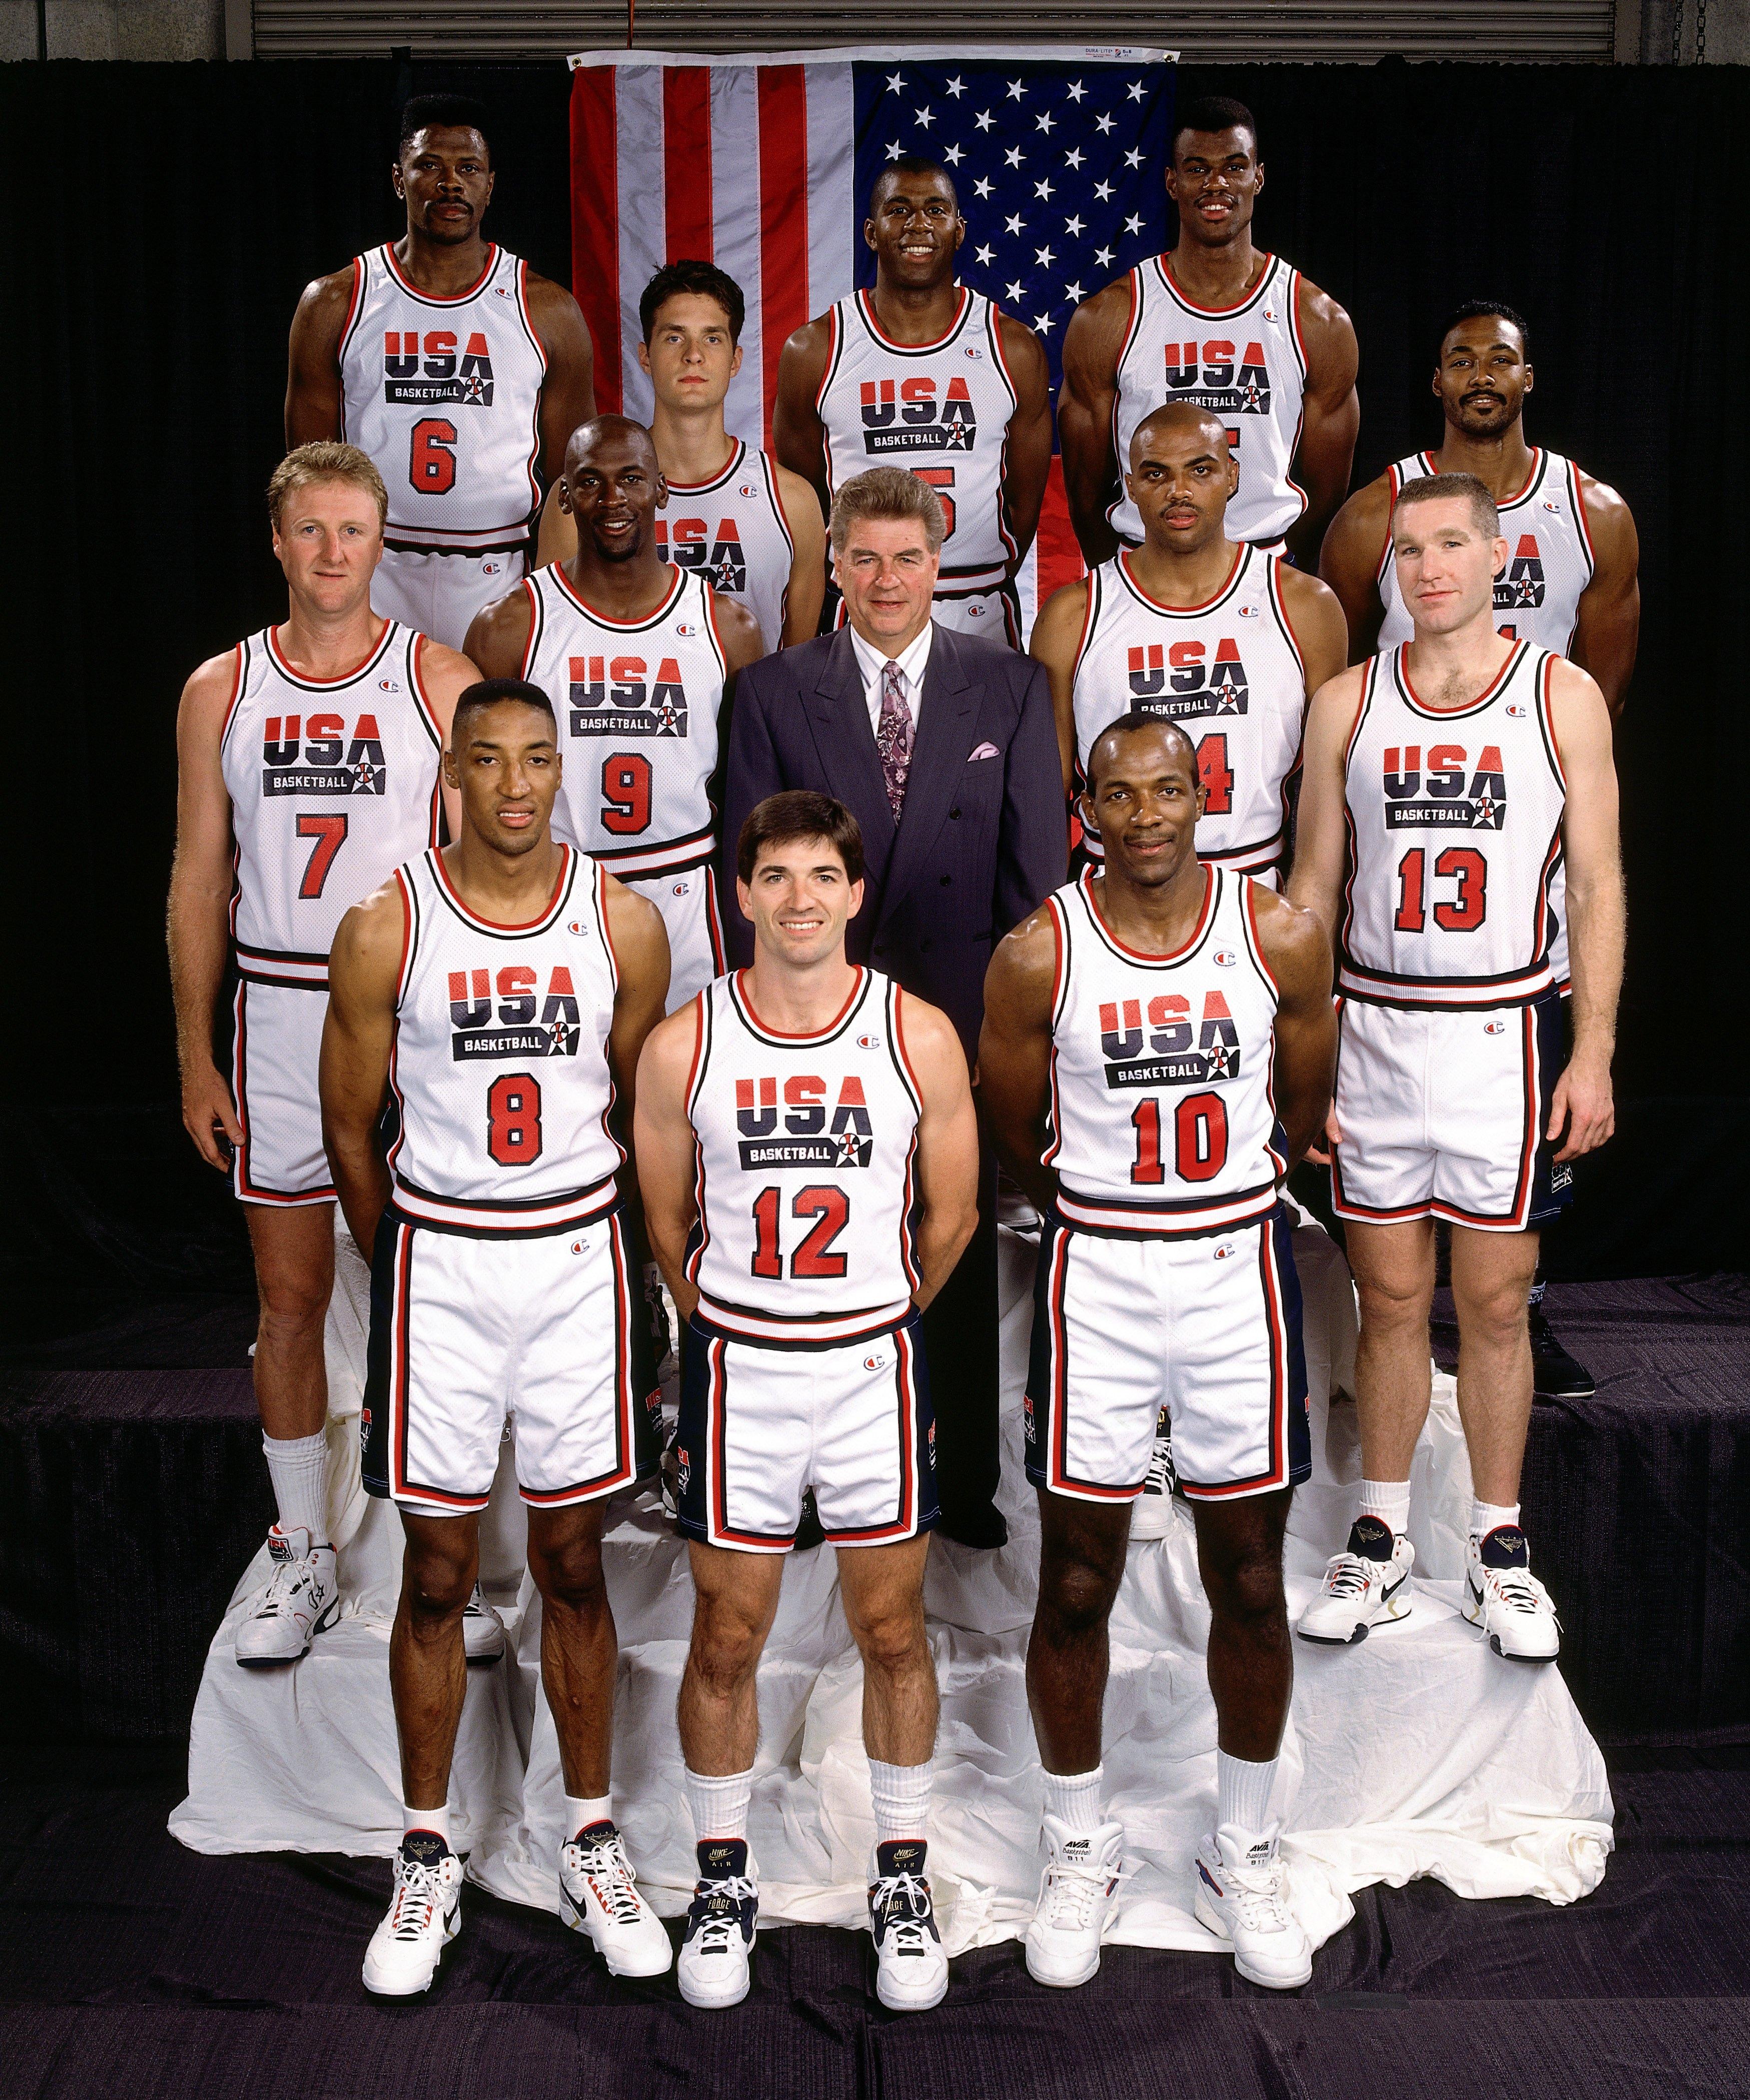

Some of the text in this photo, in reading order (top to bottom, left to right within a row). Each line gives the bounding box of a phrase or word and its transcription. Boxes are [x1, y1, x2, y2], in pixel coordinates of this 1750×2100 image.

[385, 332, 493, 378] USA
[1165, 340, 1270, 389] USA
[395, 386, 459, 398] BASKETBALL
[860, 378, 976, 427] USA
[1176, 396, 1237, 407] ASKETBALL
[410, 418, 457, 495] 6
[874, 433, 941, 447] BASKETBALL
[569, 656, 687, 708] USA
[1128, 638, 1248, 695] USA
[264, 714, 386, 766] USA
[580, 718, 651, 730] BASKETBALL
[274, 775, 347, 789] BASKETBALL
[601, 752, 652, 835] 9
[1384, 745, 1506, 800] USA
[1395, 809, 1468, 821] BASKETBALL
[296, 813, 348, 899] 7
[1394, 847, 1487, 933] 13
[448, 966, 580, 1029] USA
[465, 1036, 542, 1052] BASKETBALL
[1099, 990, 1239, 1060] USA
[1118, 1063, 1202, 1082] BASKETBALL
[487, 1073, 542, 1167] 8
[735, 1076, 872, 1137] USA
[750, 1147, 830, 1162] BASKETBALL
[1131, 1091, 1229, 1185] 10
[751, 1185, 849, 1280] 12
[711, 1848, 728, 1857] NIKE
[897, 1848, 915, 1857] NIKE
[1063, 1847, 1092, 1855] Basketball
[708, 1898, 730, 1909] FORCE
